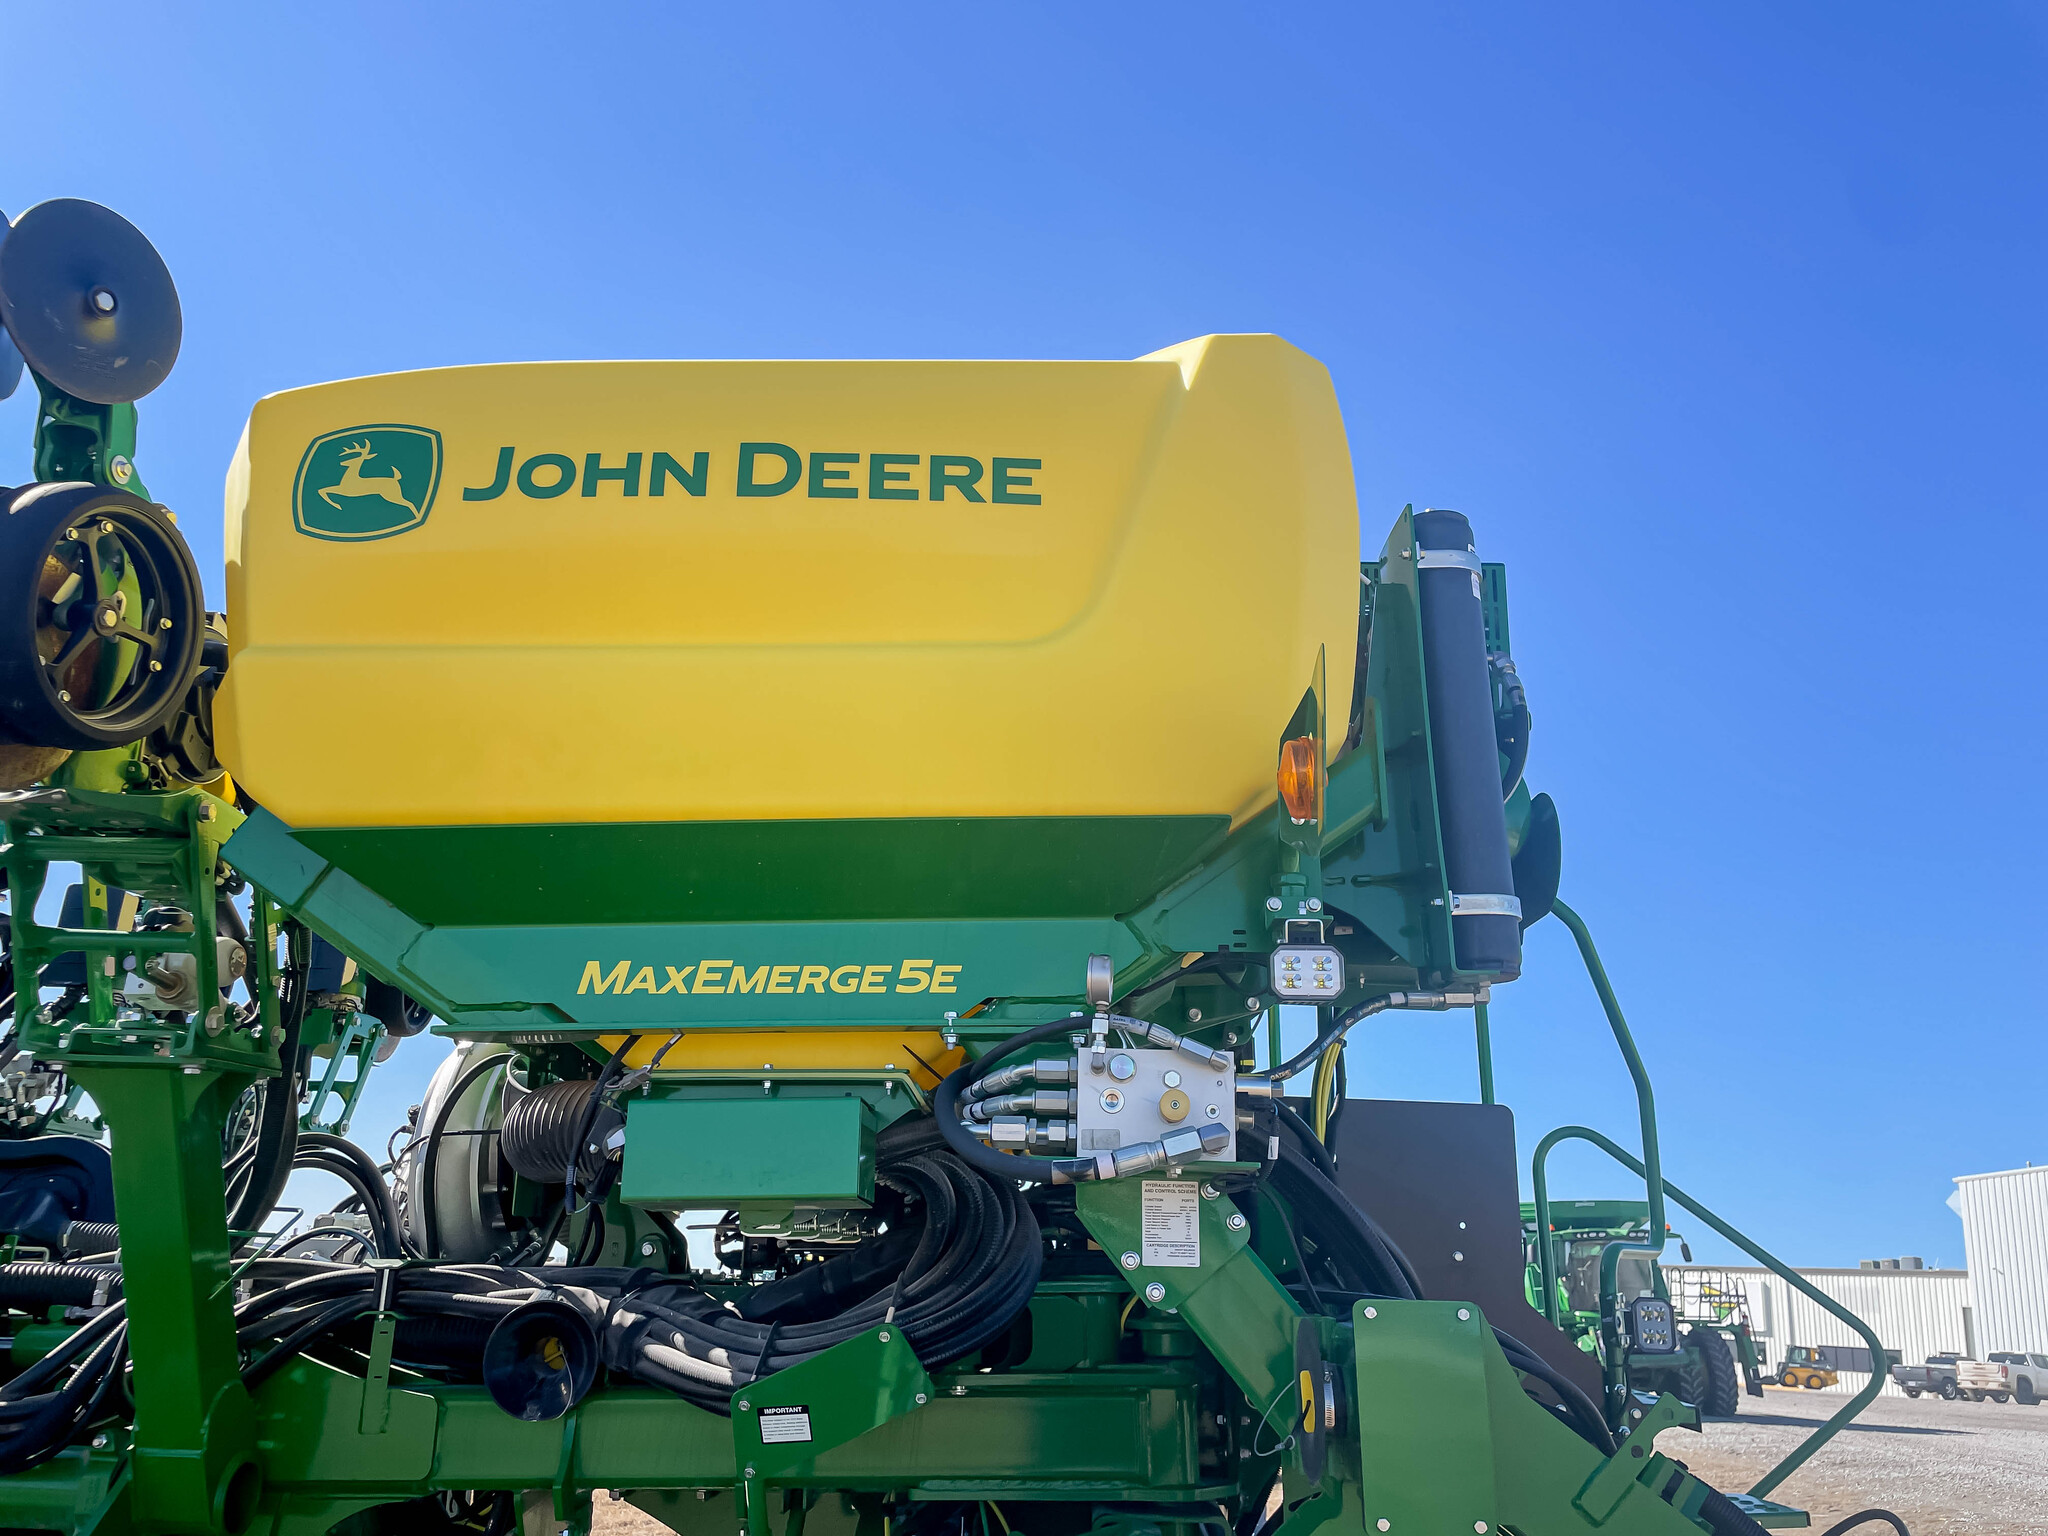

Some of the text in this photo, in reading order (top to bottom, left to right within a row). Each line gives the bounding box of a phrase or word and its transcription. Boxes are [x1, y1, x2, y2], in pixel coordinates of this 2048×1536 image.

[462, 442, 1042, 505] JOHN DEERE
[576, 959, 963, 995] MAXEMERGE 5E
[763, 1406, 802, 1414] IMPORTANT
